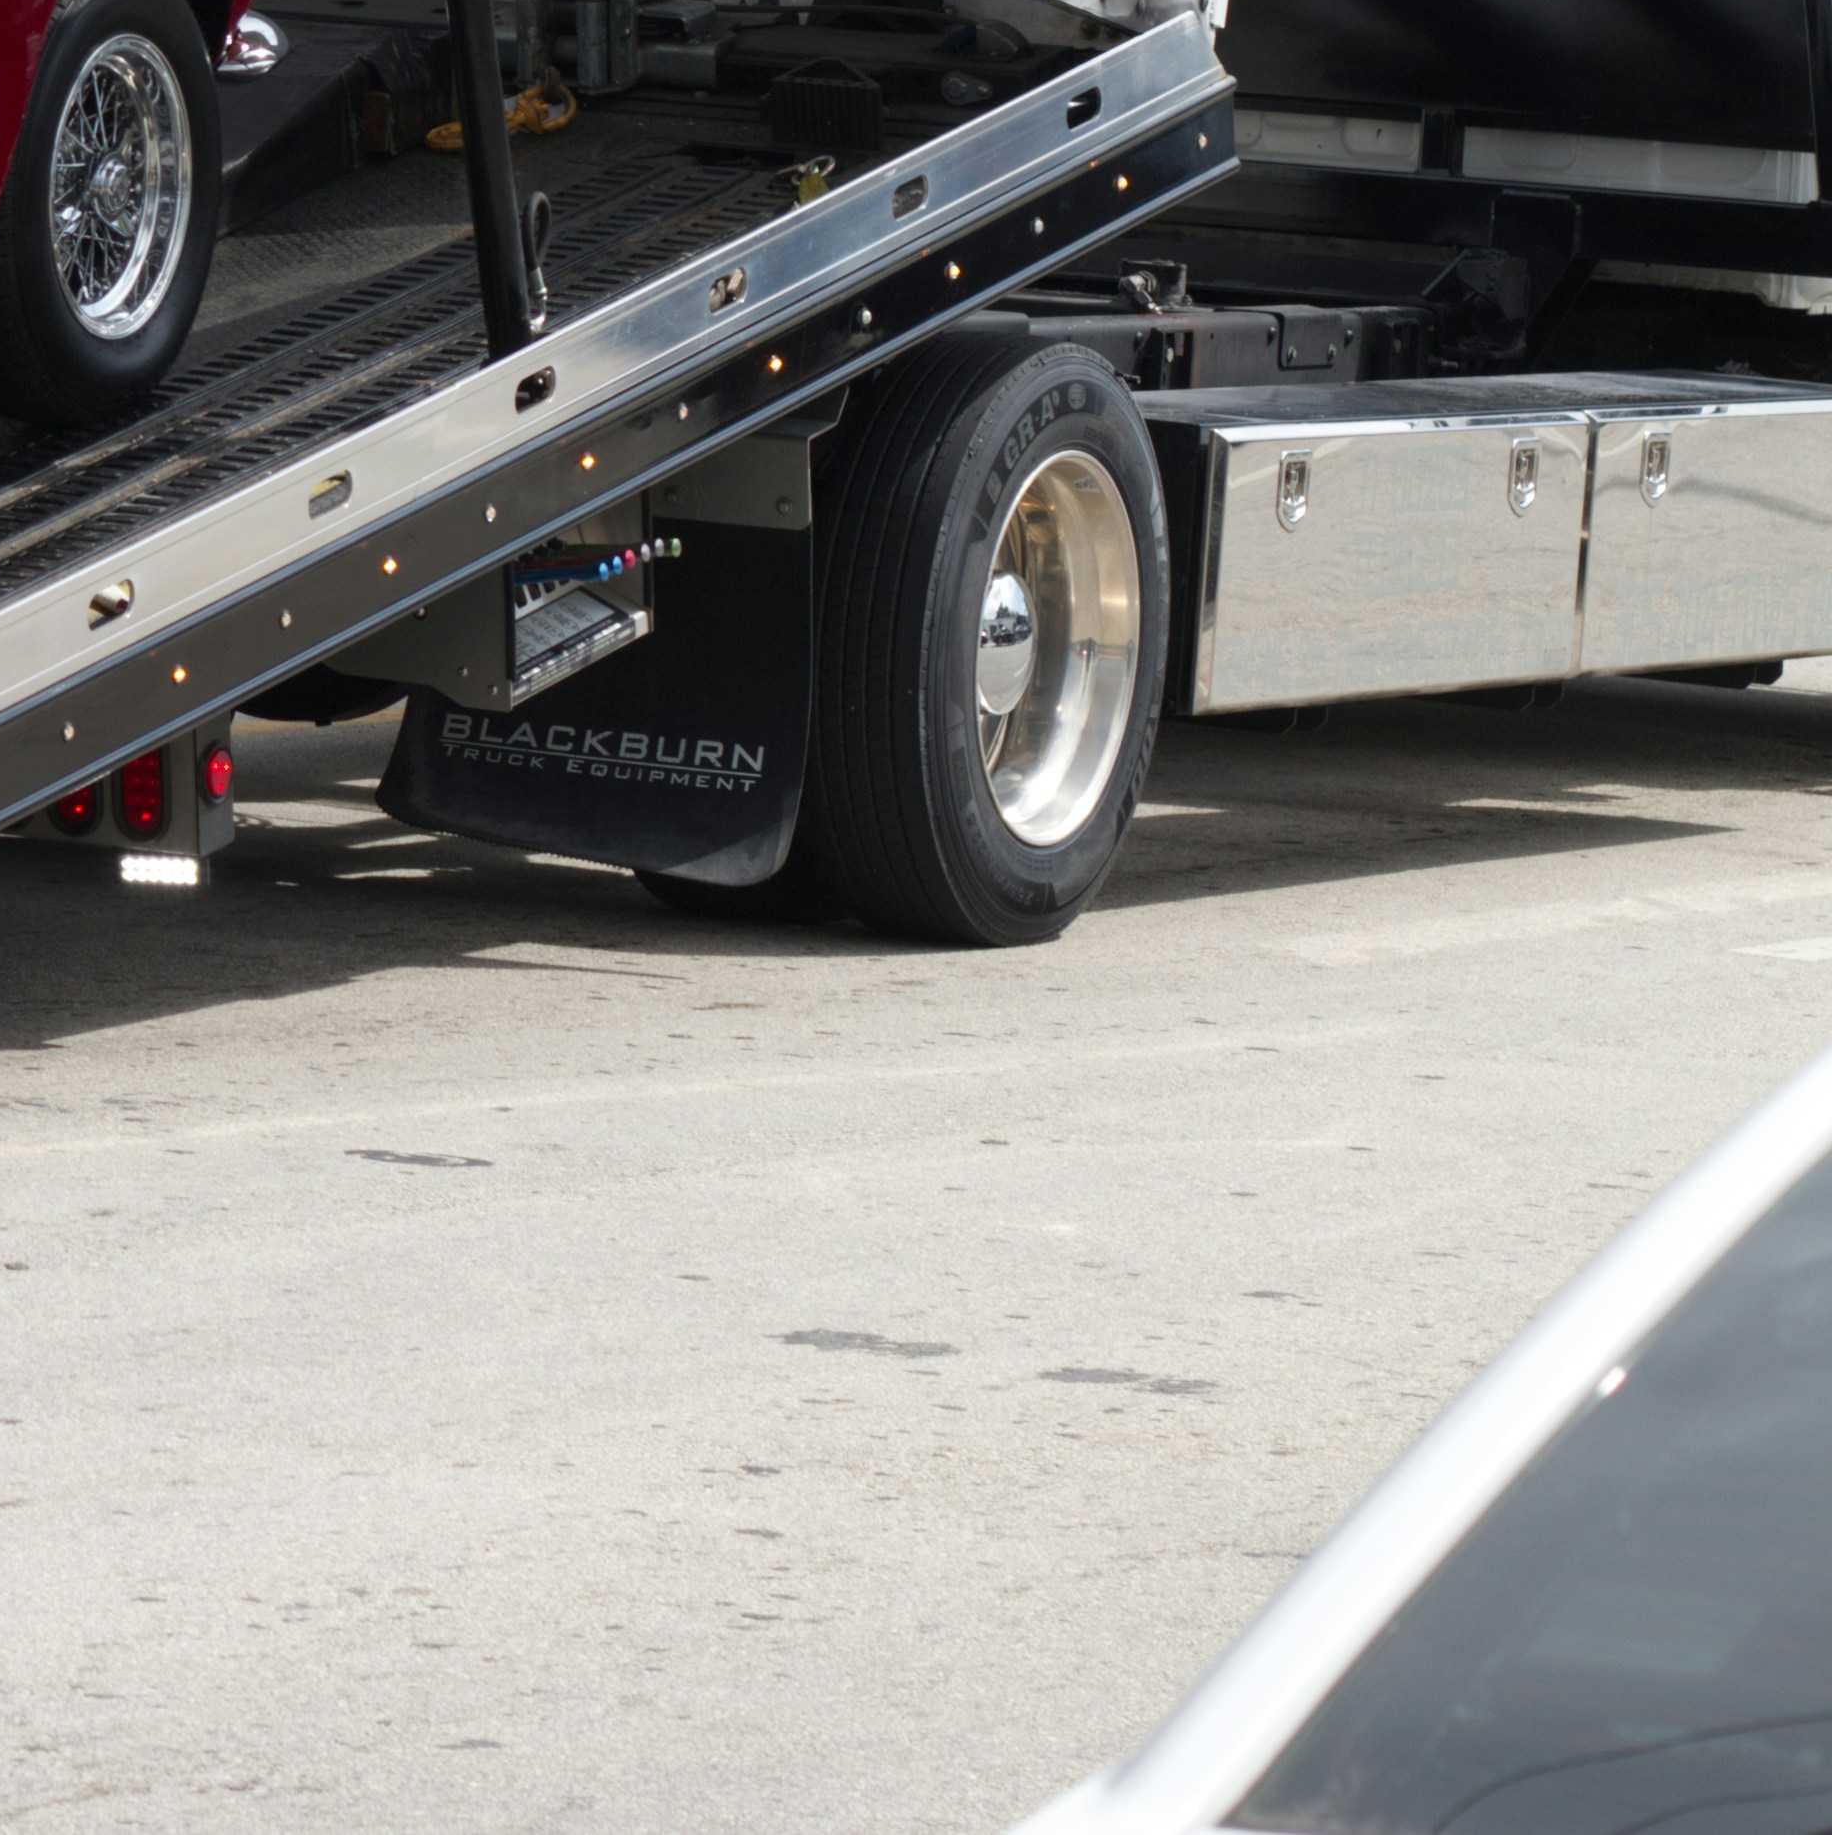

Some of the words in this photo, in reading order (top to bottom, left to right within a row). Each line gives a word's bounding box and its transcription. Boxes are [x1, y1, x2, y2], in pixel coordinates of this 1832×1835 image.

[442, 713, 764, 772] BLACKBURN
[443, 743, 544, 770] TRUCK
[566, 759, 756, 793] EQUIPMENT
